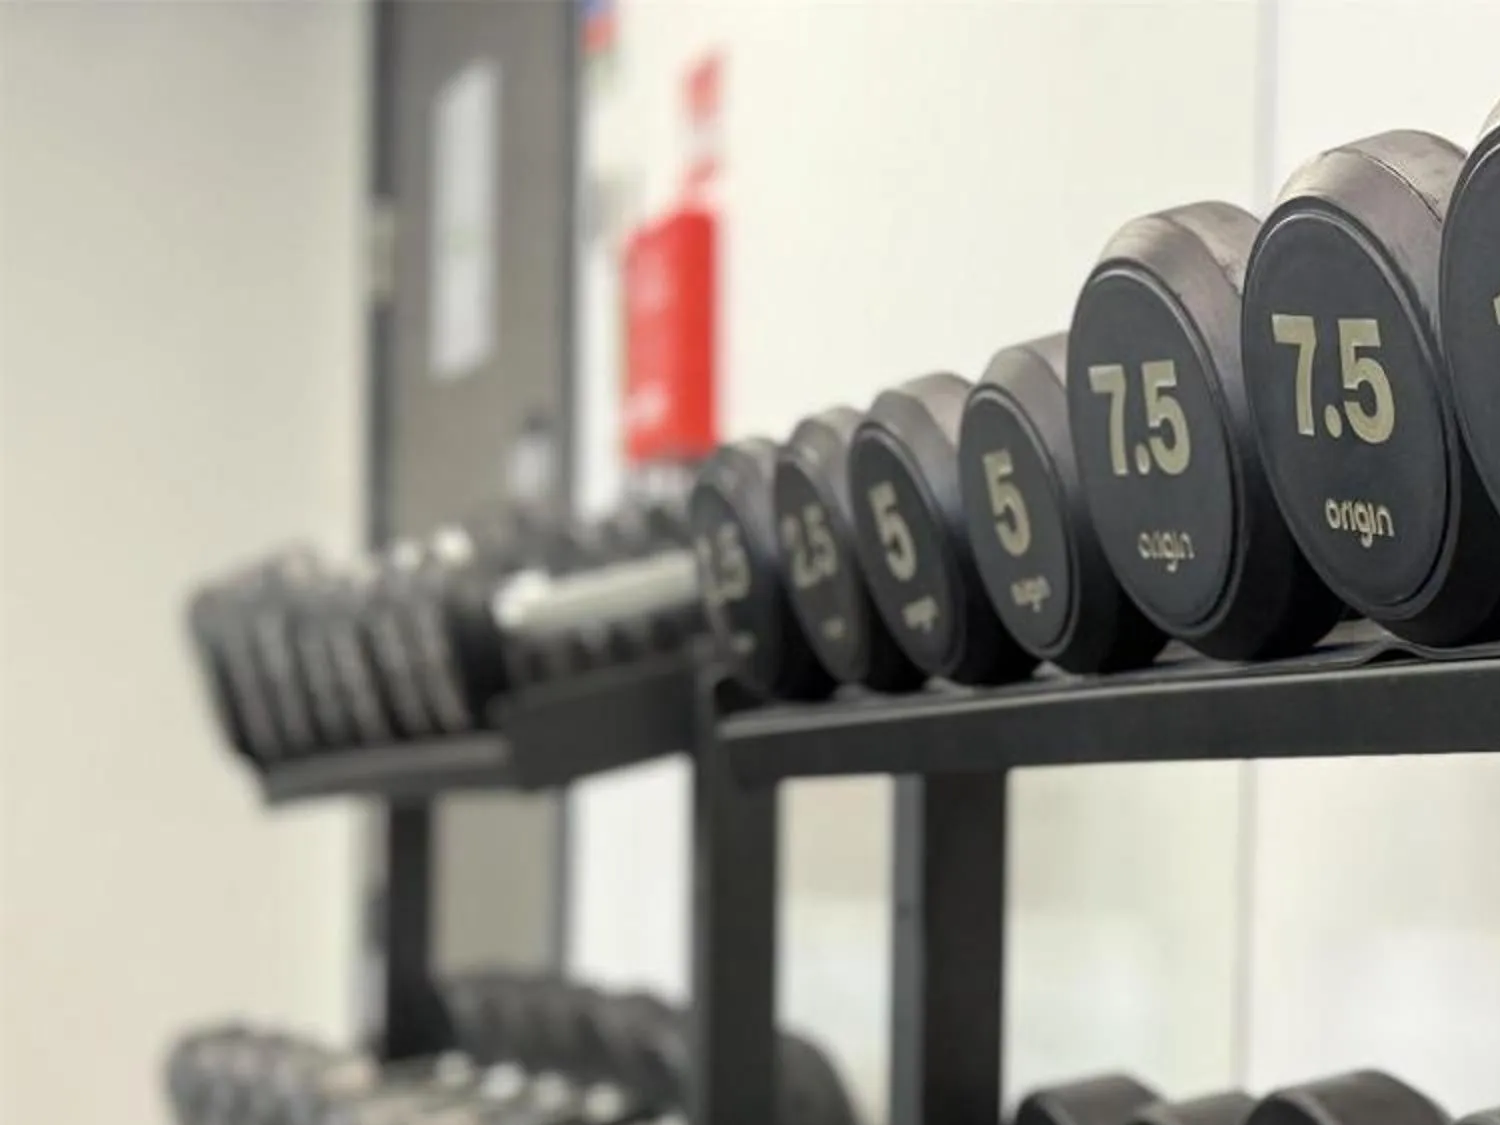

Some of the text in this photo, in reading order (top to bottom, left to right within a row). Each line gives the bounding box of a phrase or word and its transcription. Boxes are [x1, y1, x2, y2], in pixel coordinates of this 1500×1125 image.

[1087, 359, 1191, 476] 7.5
[1271, 313, 1394, 445] 7.5
[867, 481, 916, 581] 5
[983, 449, 1031, 557] 5
[1325, 497, 1394, 547] origin
